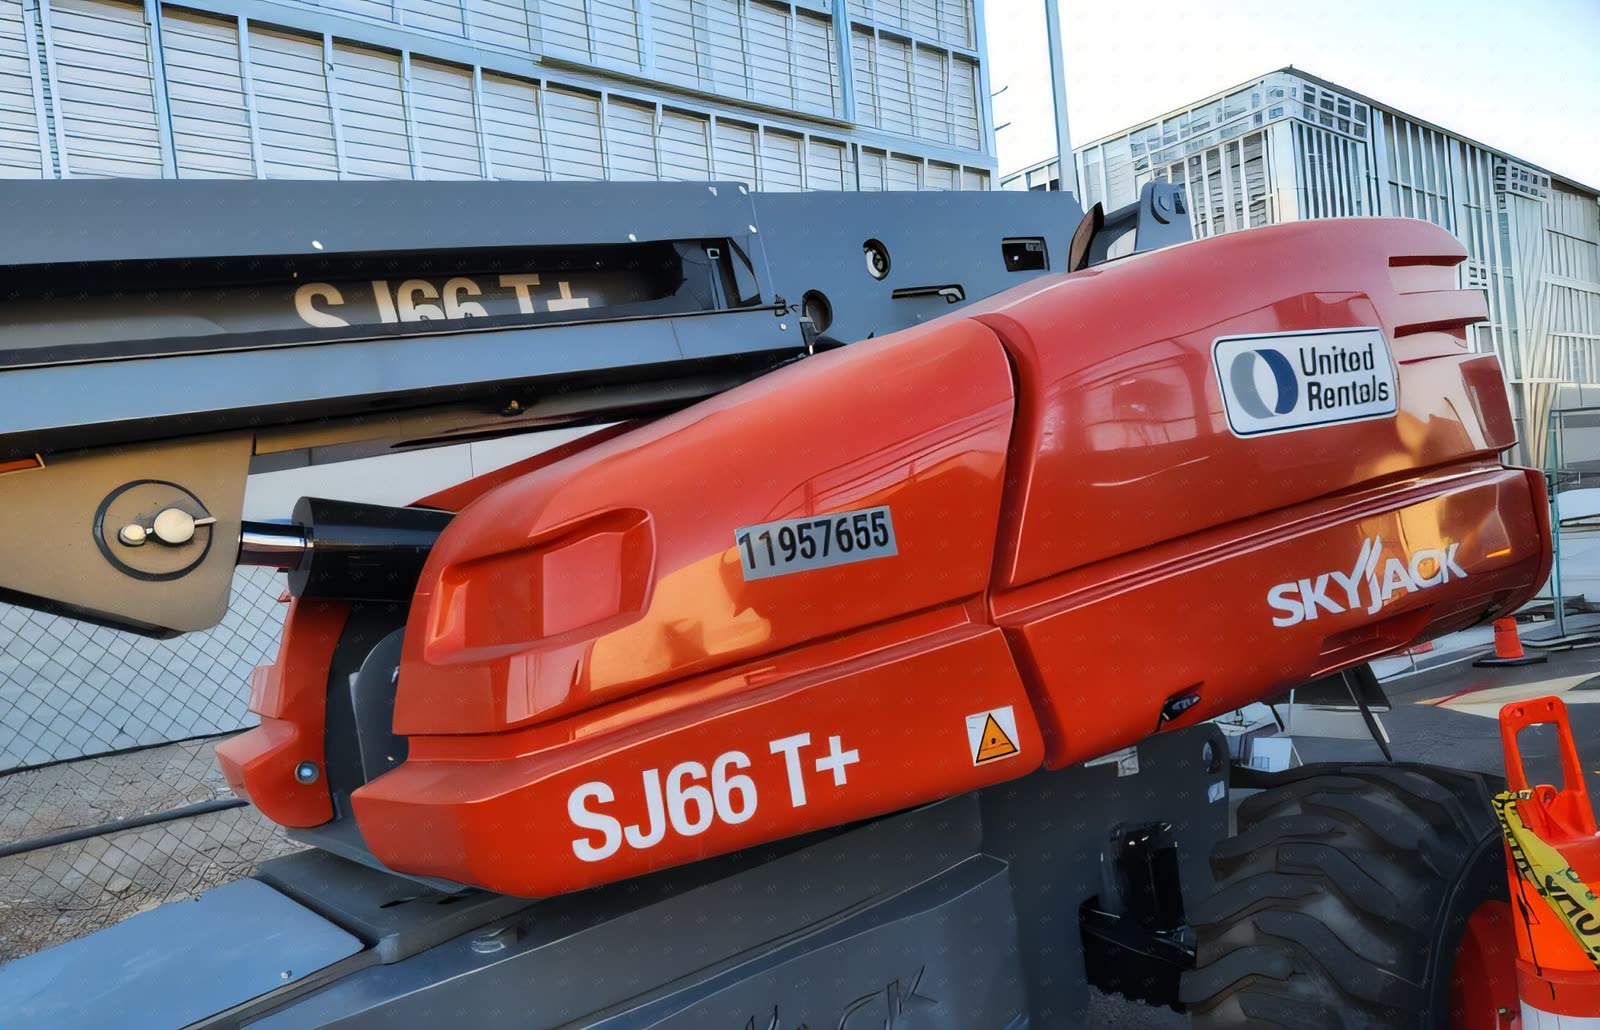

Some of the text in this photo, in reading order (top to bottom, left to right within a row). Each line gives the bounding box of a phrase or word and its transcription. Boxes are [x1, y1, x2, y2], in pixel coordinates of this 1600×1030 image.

[1299, 343, 1375, 377] United
[1307, 375, 1389, 412] Rentals
[738, 511, 889, 569] 11957655
[1267, 534, 1468, 627] SKYJACK
[567, 732, 860, 862] SJ66 T+
